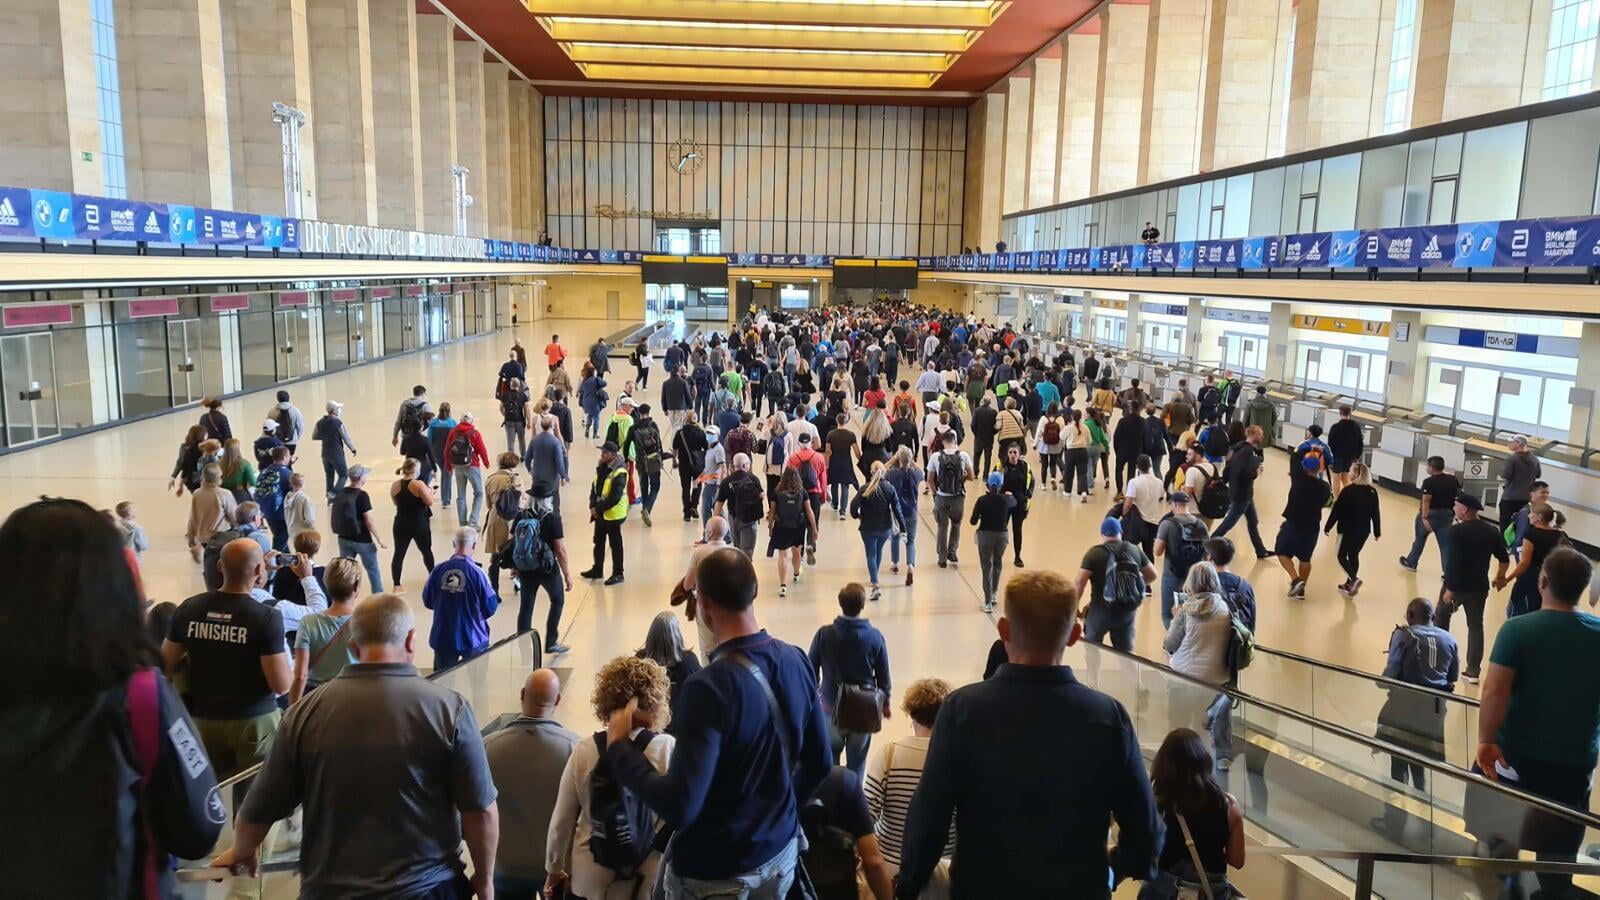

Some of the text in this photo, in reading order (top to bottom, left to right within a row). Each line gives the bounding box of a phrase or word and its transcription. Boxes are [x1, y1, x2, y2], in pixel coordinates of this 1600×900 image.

[305, 221, 329, 253] DER
[1545, 231, 1566, 241] BMW
[1421, 251, 1442, 259] adidas
[187, 621, 248, 644] FINISHER
